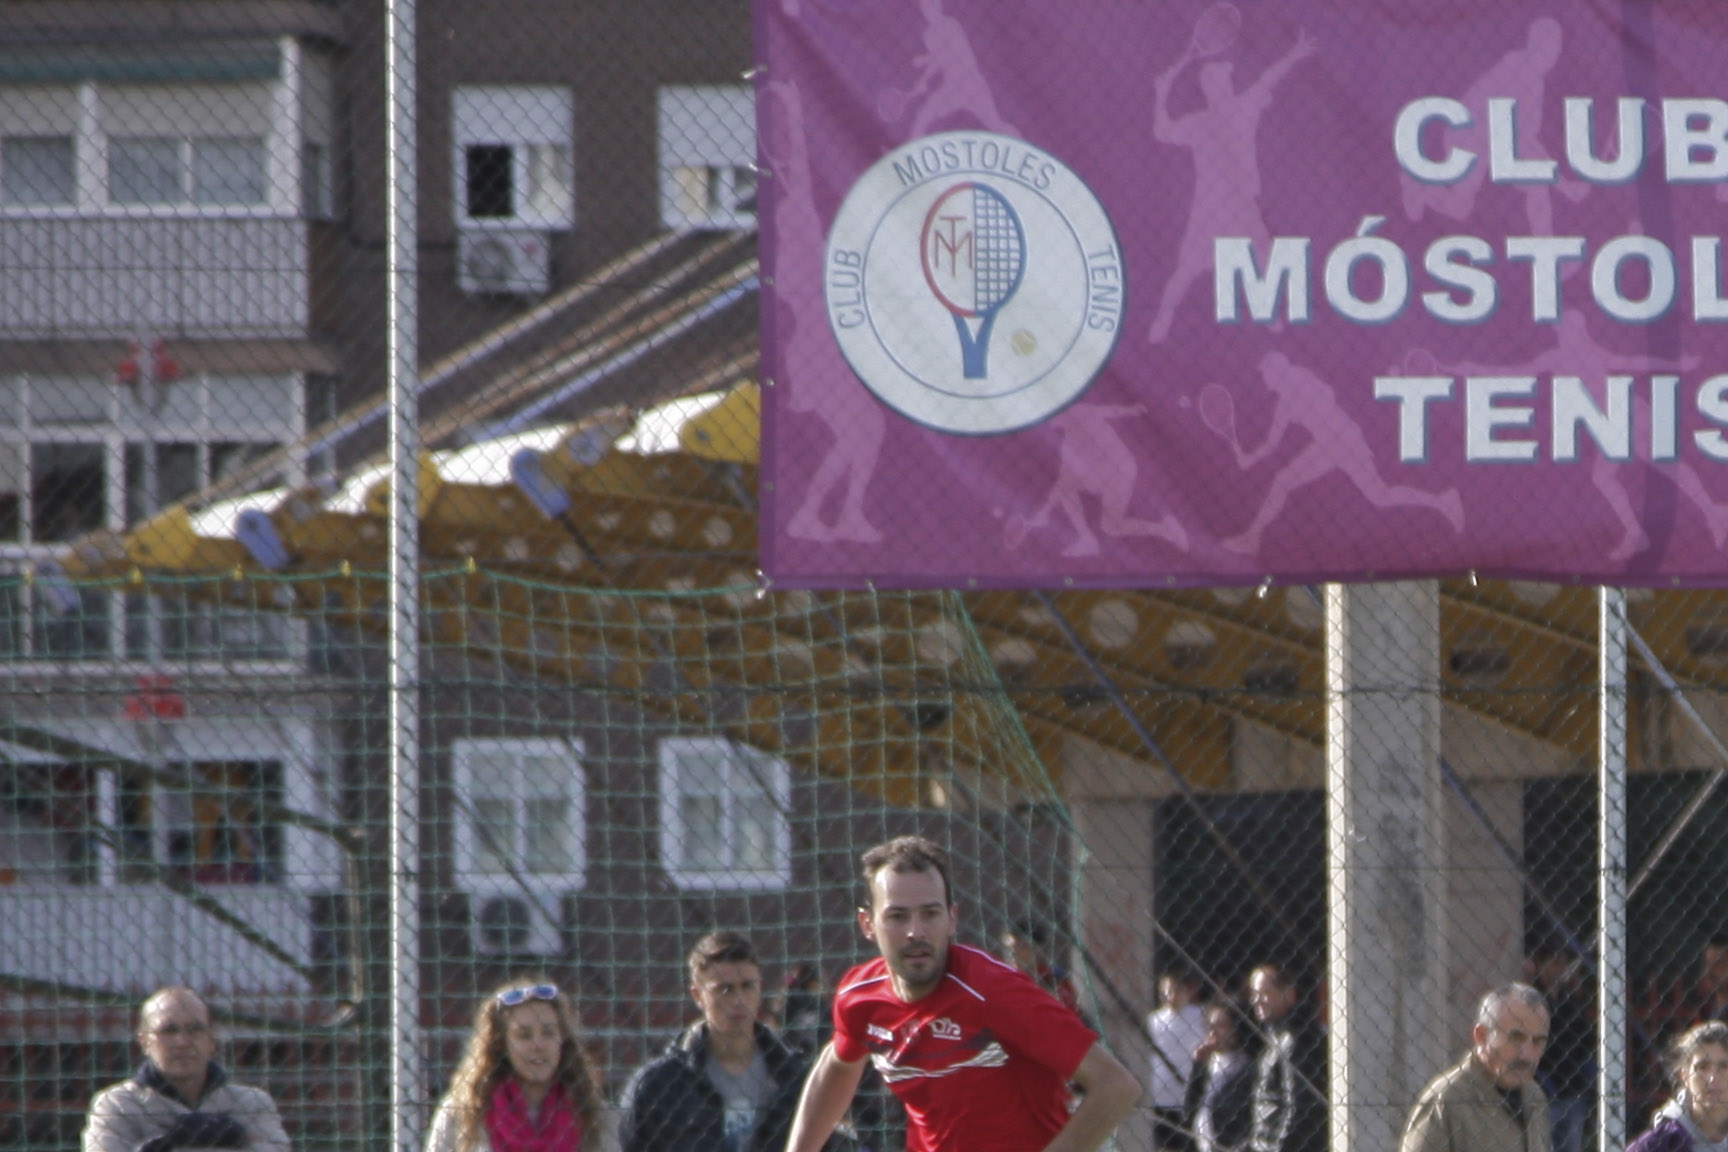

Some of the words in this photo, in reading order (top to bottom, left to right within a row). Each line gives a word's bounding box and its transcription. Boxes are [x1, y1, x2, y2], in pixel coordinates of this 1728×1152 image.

[892, 139, 1056, 190] MOSTOLES
[831, 250, 866, 329] CLUB
[1087, 244, 1120, 334] TENIS
